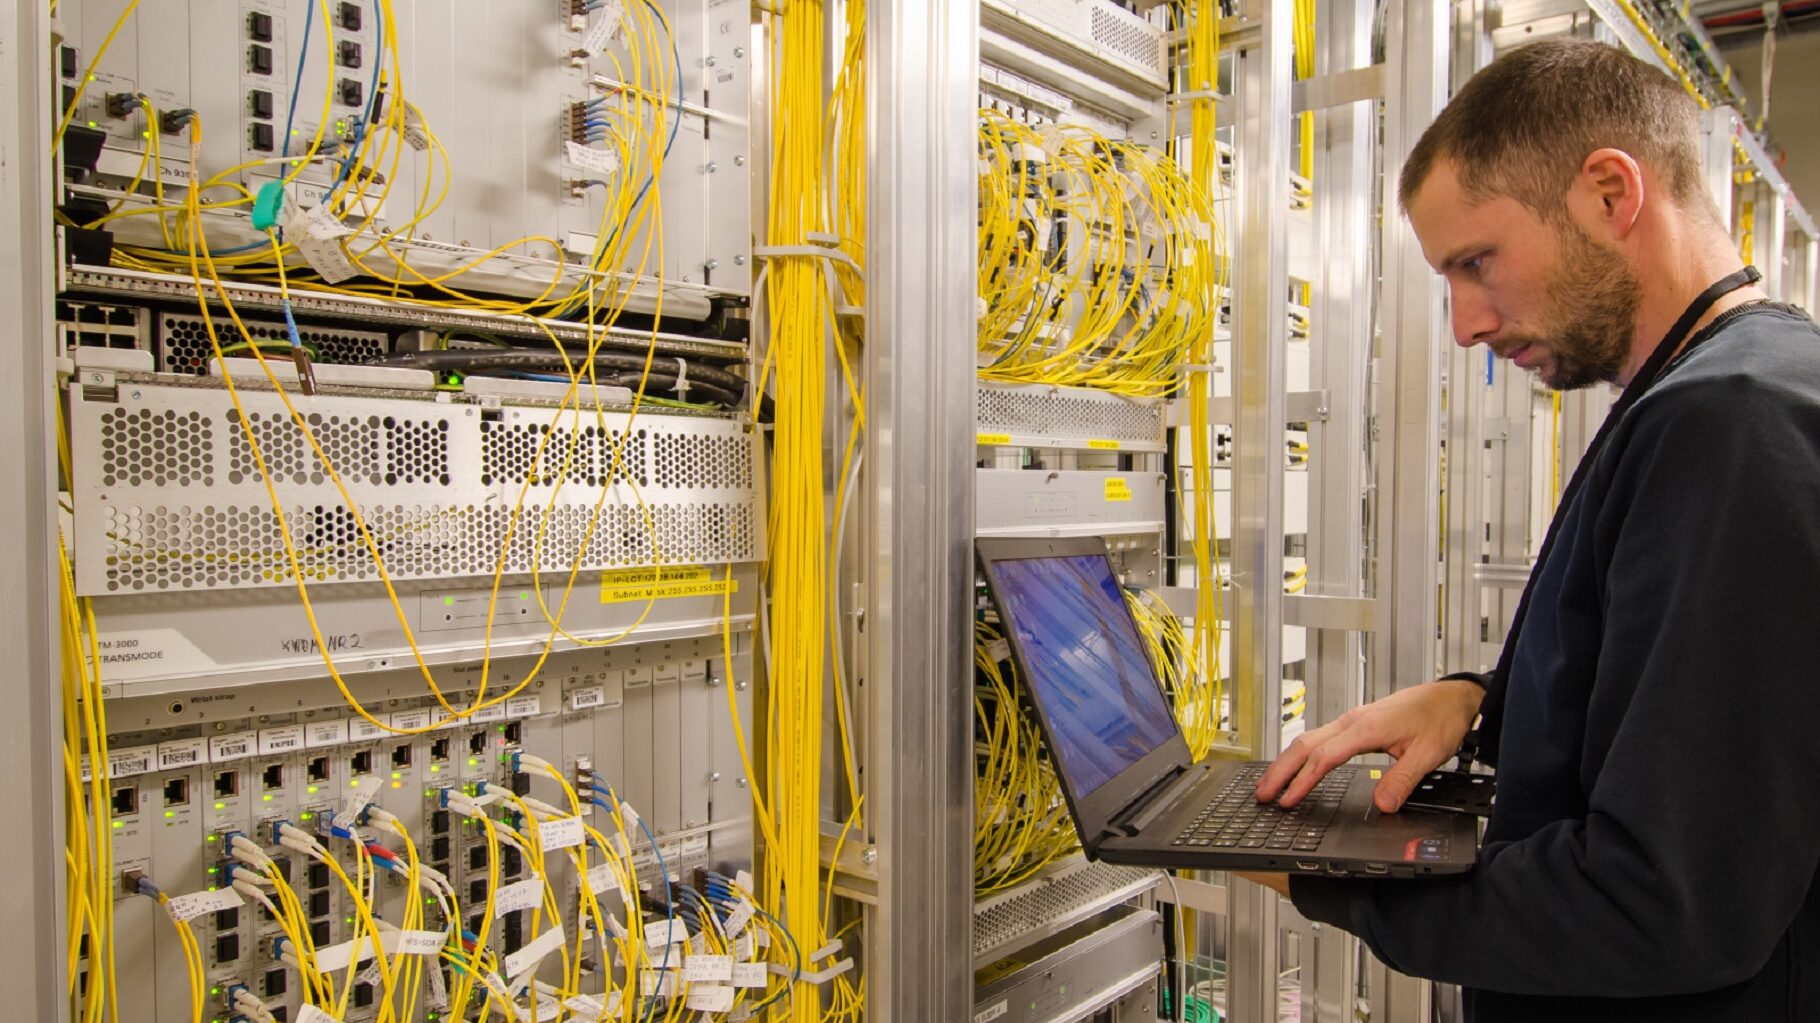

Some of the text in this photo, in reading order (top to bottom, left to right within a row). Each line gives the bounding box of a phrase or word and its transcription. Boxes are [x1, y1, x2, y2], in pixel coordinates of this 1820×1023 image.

[613, 571, 699, 584] IP-LCT:17228.144.202
[613, 583, 727, 599] Subnet Msk:255.255.255.252
[98, 650, 164, 664] TRANSMODE
[190, 693, 236, 704] Wrist strap
